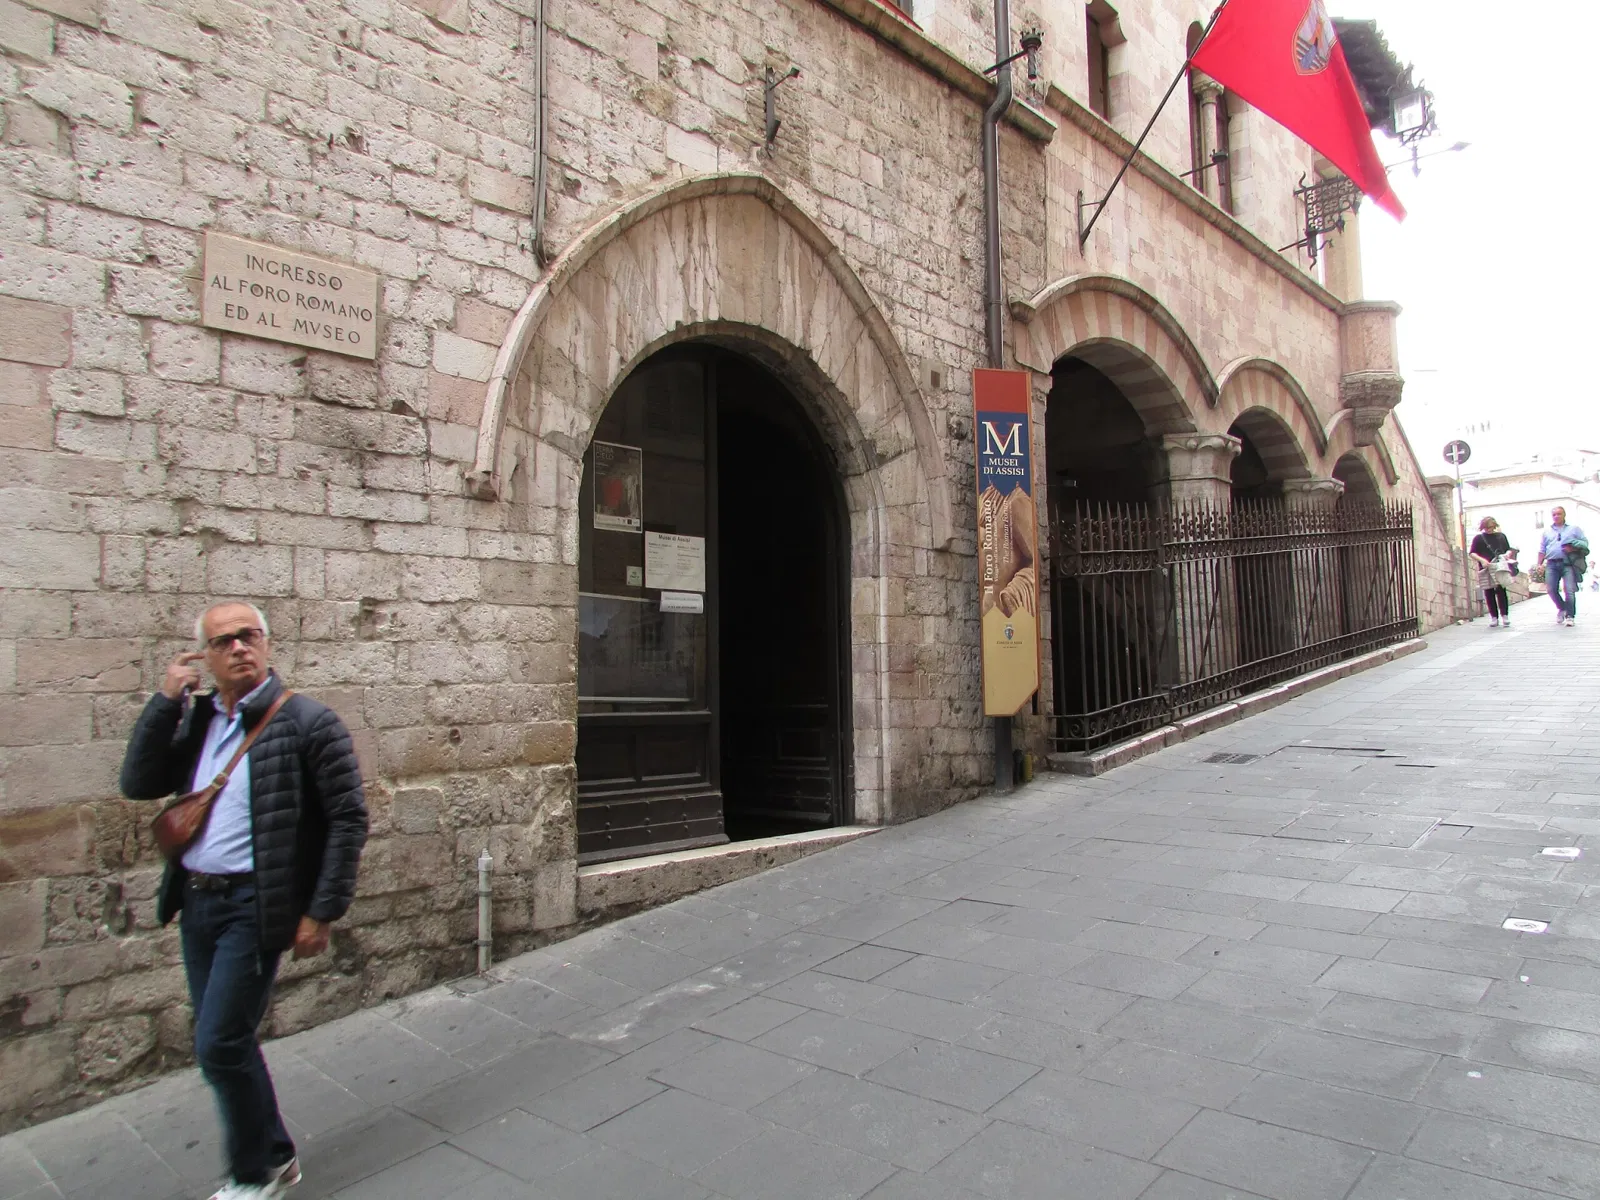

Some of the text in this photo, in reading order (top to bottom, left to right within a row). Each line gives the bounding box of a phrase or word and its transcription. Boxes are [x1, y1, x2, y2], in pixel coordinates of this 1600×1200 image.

[246, 254, 343, 291] INGRESSO
[211, 274, 372, 322] AL FORO ROMANO
[224, 303, 361, 344] ED AL MVSEO
[983, 466, 1024, 476] DI ASSISI
[988, 457, 1019, 466] MUSEI
[983, 500, 994, 594] Il Foro Romano
